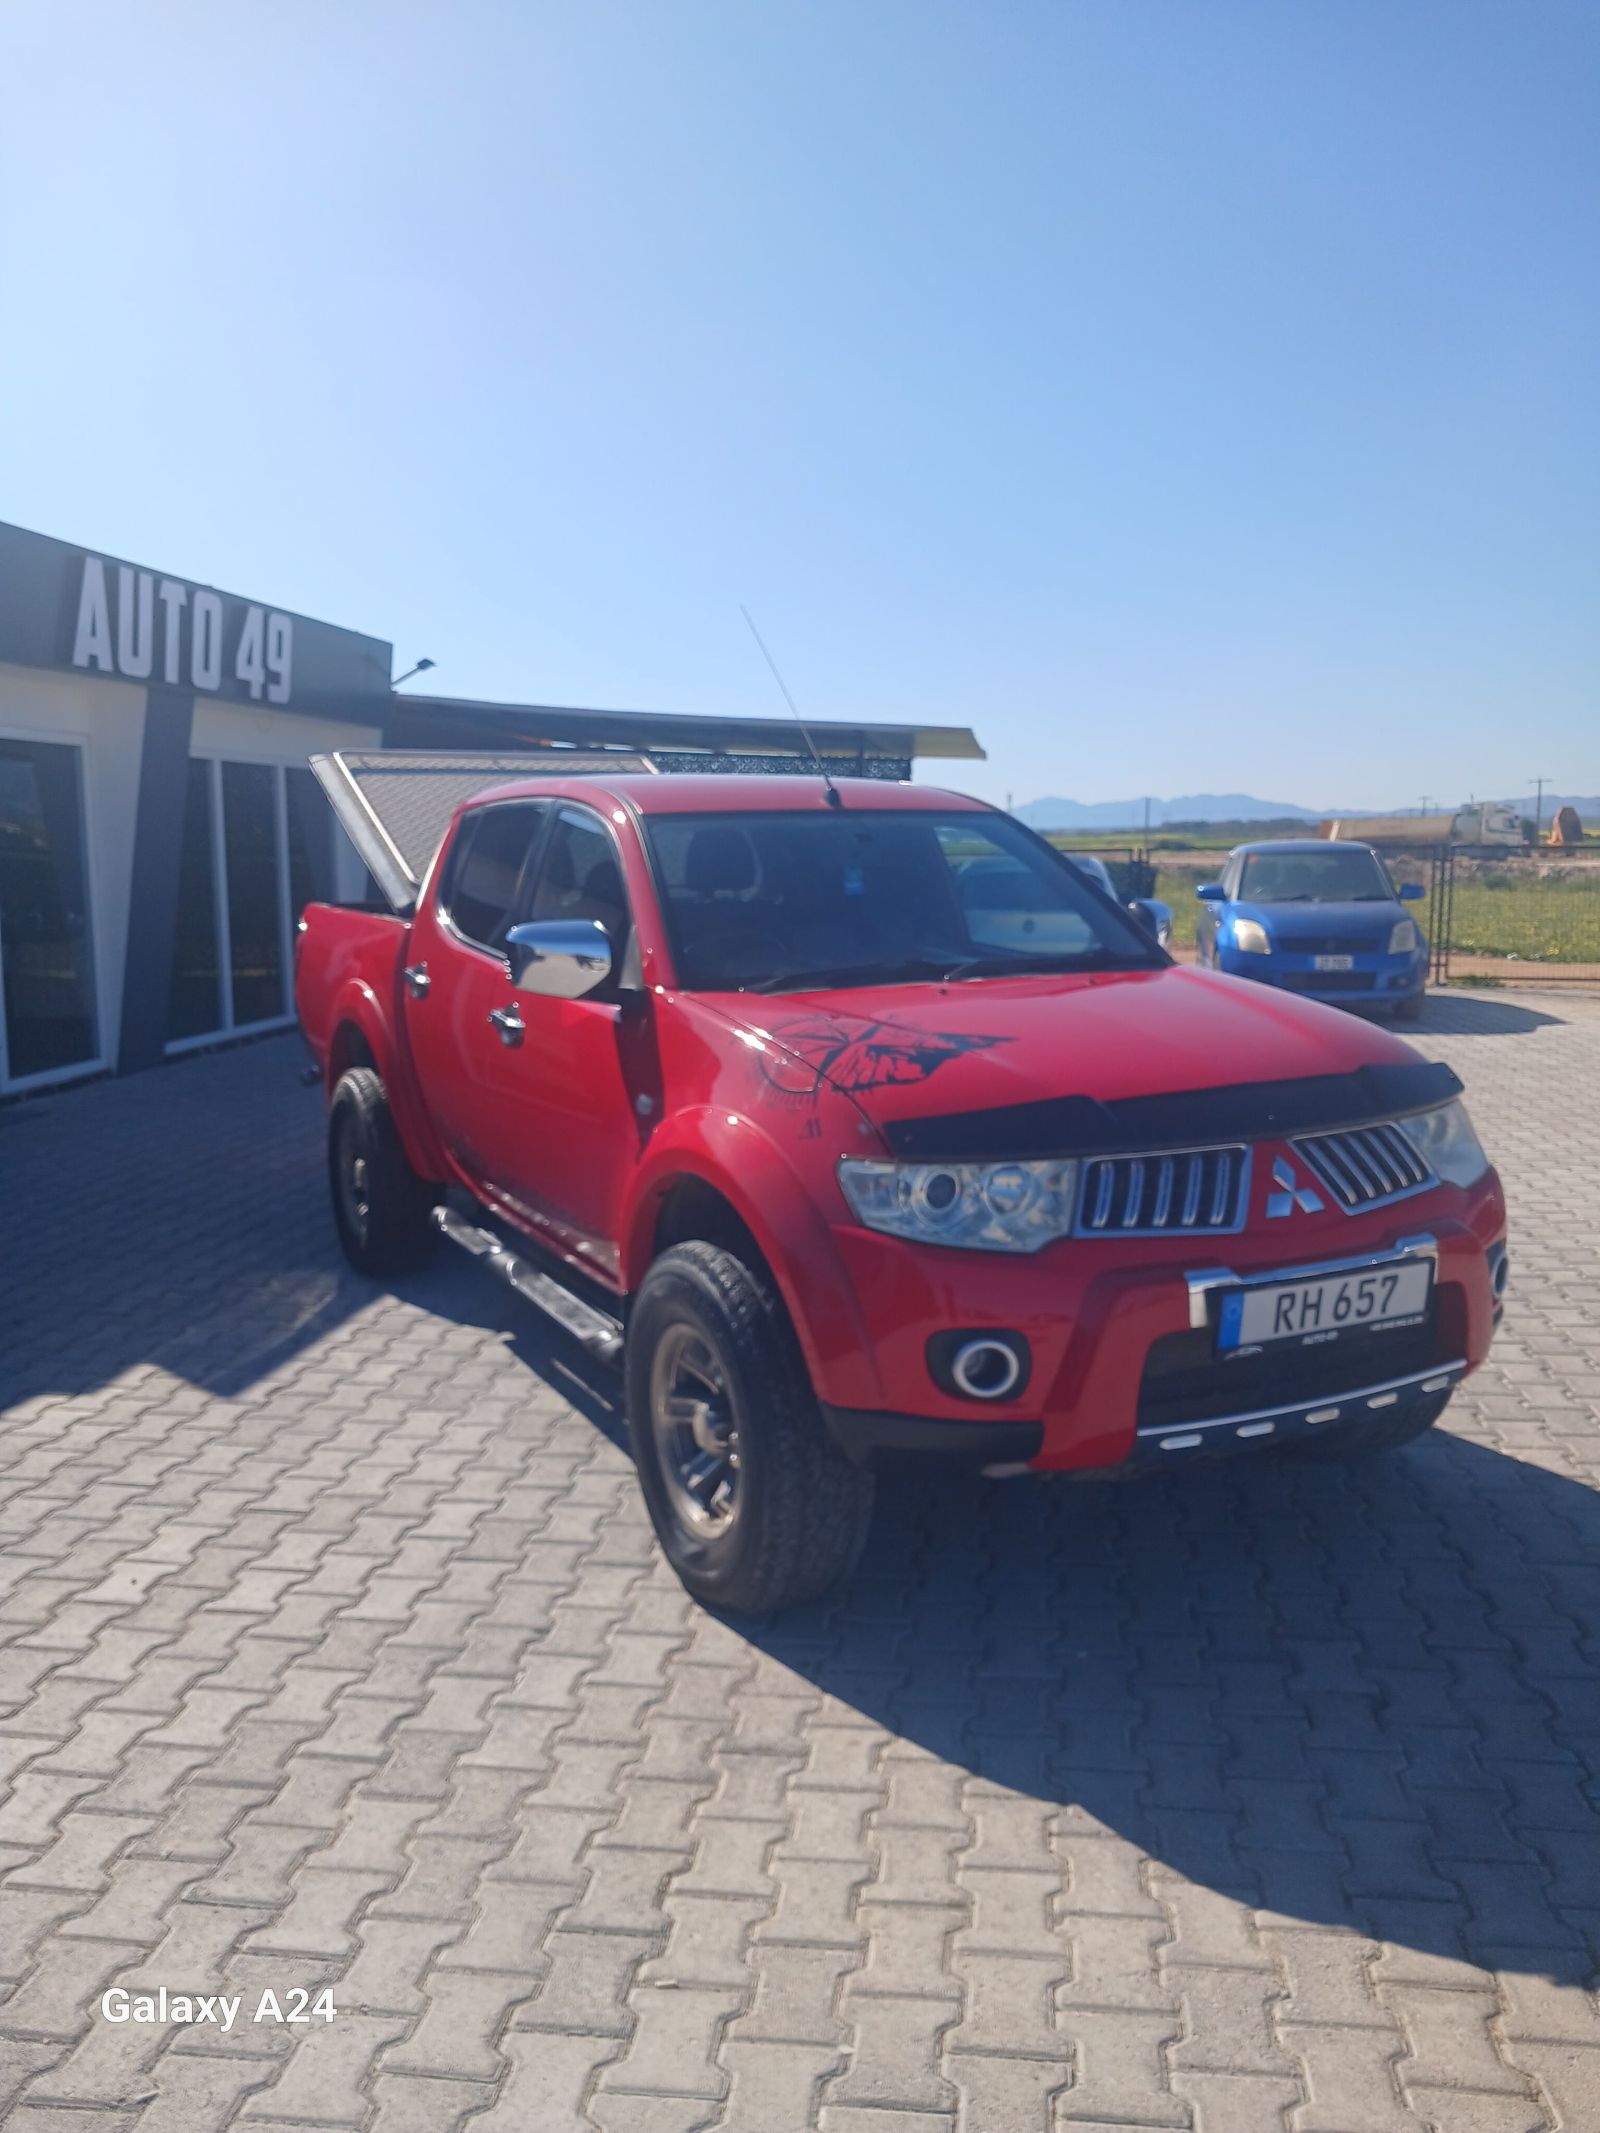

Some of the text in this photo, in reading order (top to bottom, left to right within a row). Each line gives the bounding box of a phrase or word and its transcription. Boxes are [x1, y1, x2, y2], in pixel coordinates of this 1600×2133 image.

[72, 555, 293, 704] AUTO 49
[1273, 1274, 1399, 1334] RH 657
